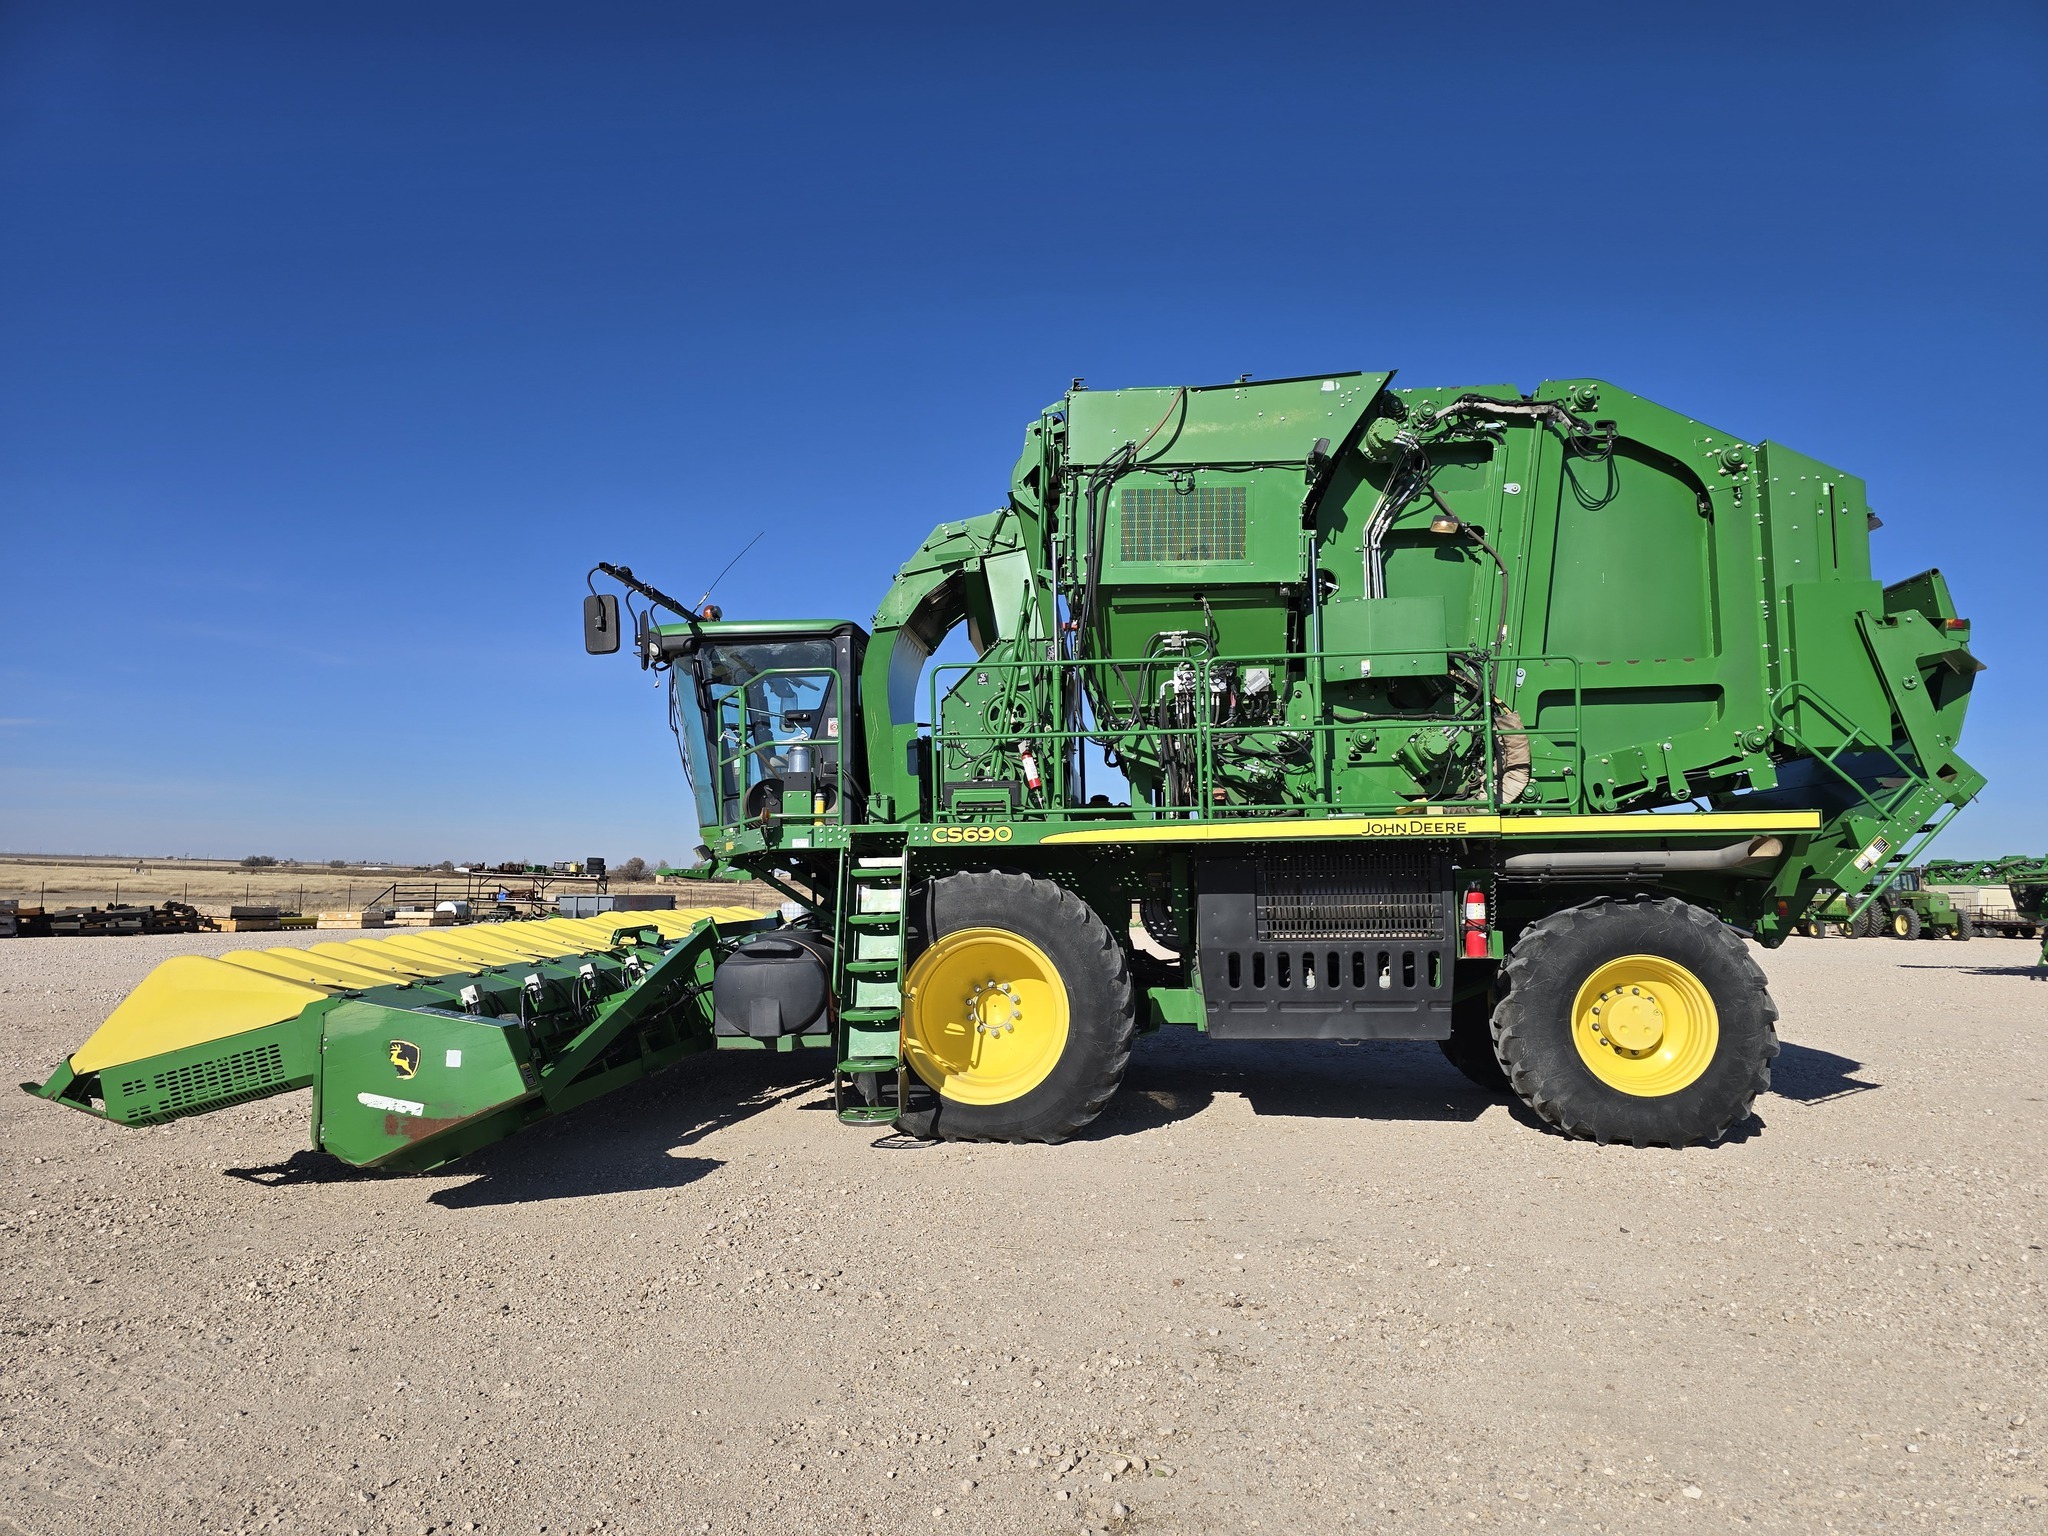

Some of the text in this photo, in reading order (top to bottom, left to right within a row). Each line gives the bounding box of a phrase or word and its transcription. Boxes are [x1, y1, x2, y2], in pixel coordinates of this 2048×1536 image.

[932, 826, 1013, 843] CS690
[1362, 820, 1467, 834] JOHN DEERE
